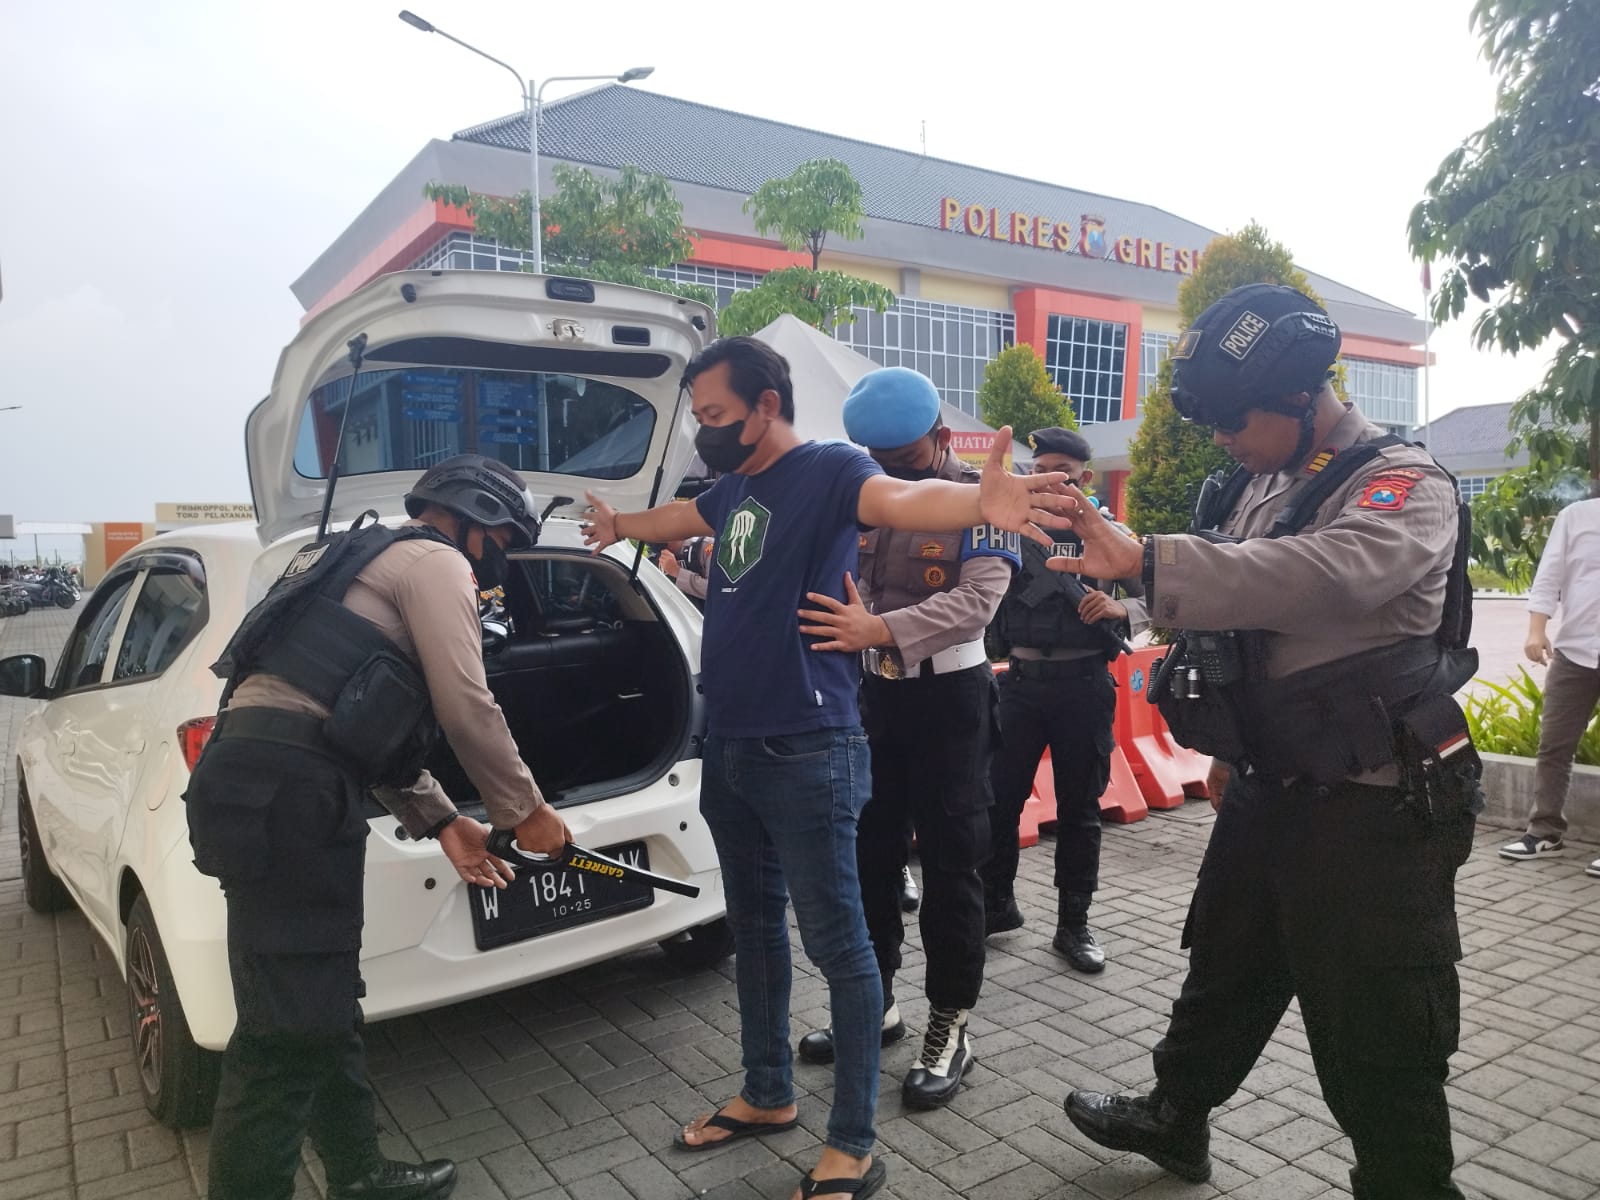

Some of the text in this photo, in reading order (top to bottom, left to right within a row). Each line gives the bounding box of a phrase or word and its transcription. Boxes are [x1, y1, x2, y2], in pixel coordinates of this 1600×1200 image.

[941, 197, 1071, 251] POLRES
[1225, 314, 1265, 355] POLICE
[568, 856, 625, 878] GARRETT
[481, 886, 499, 920] W
